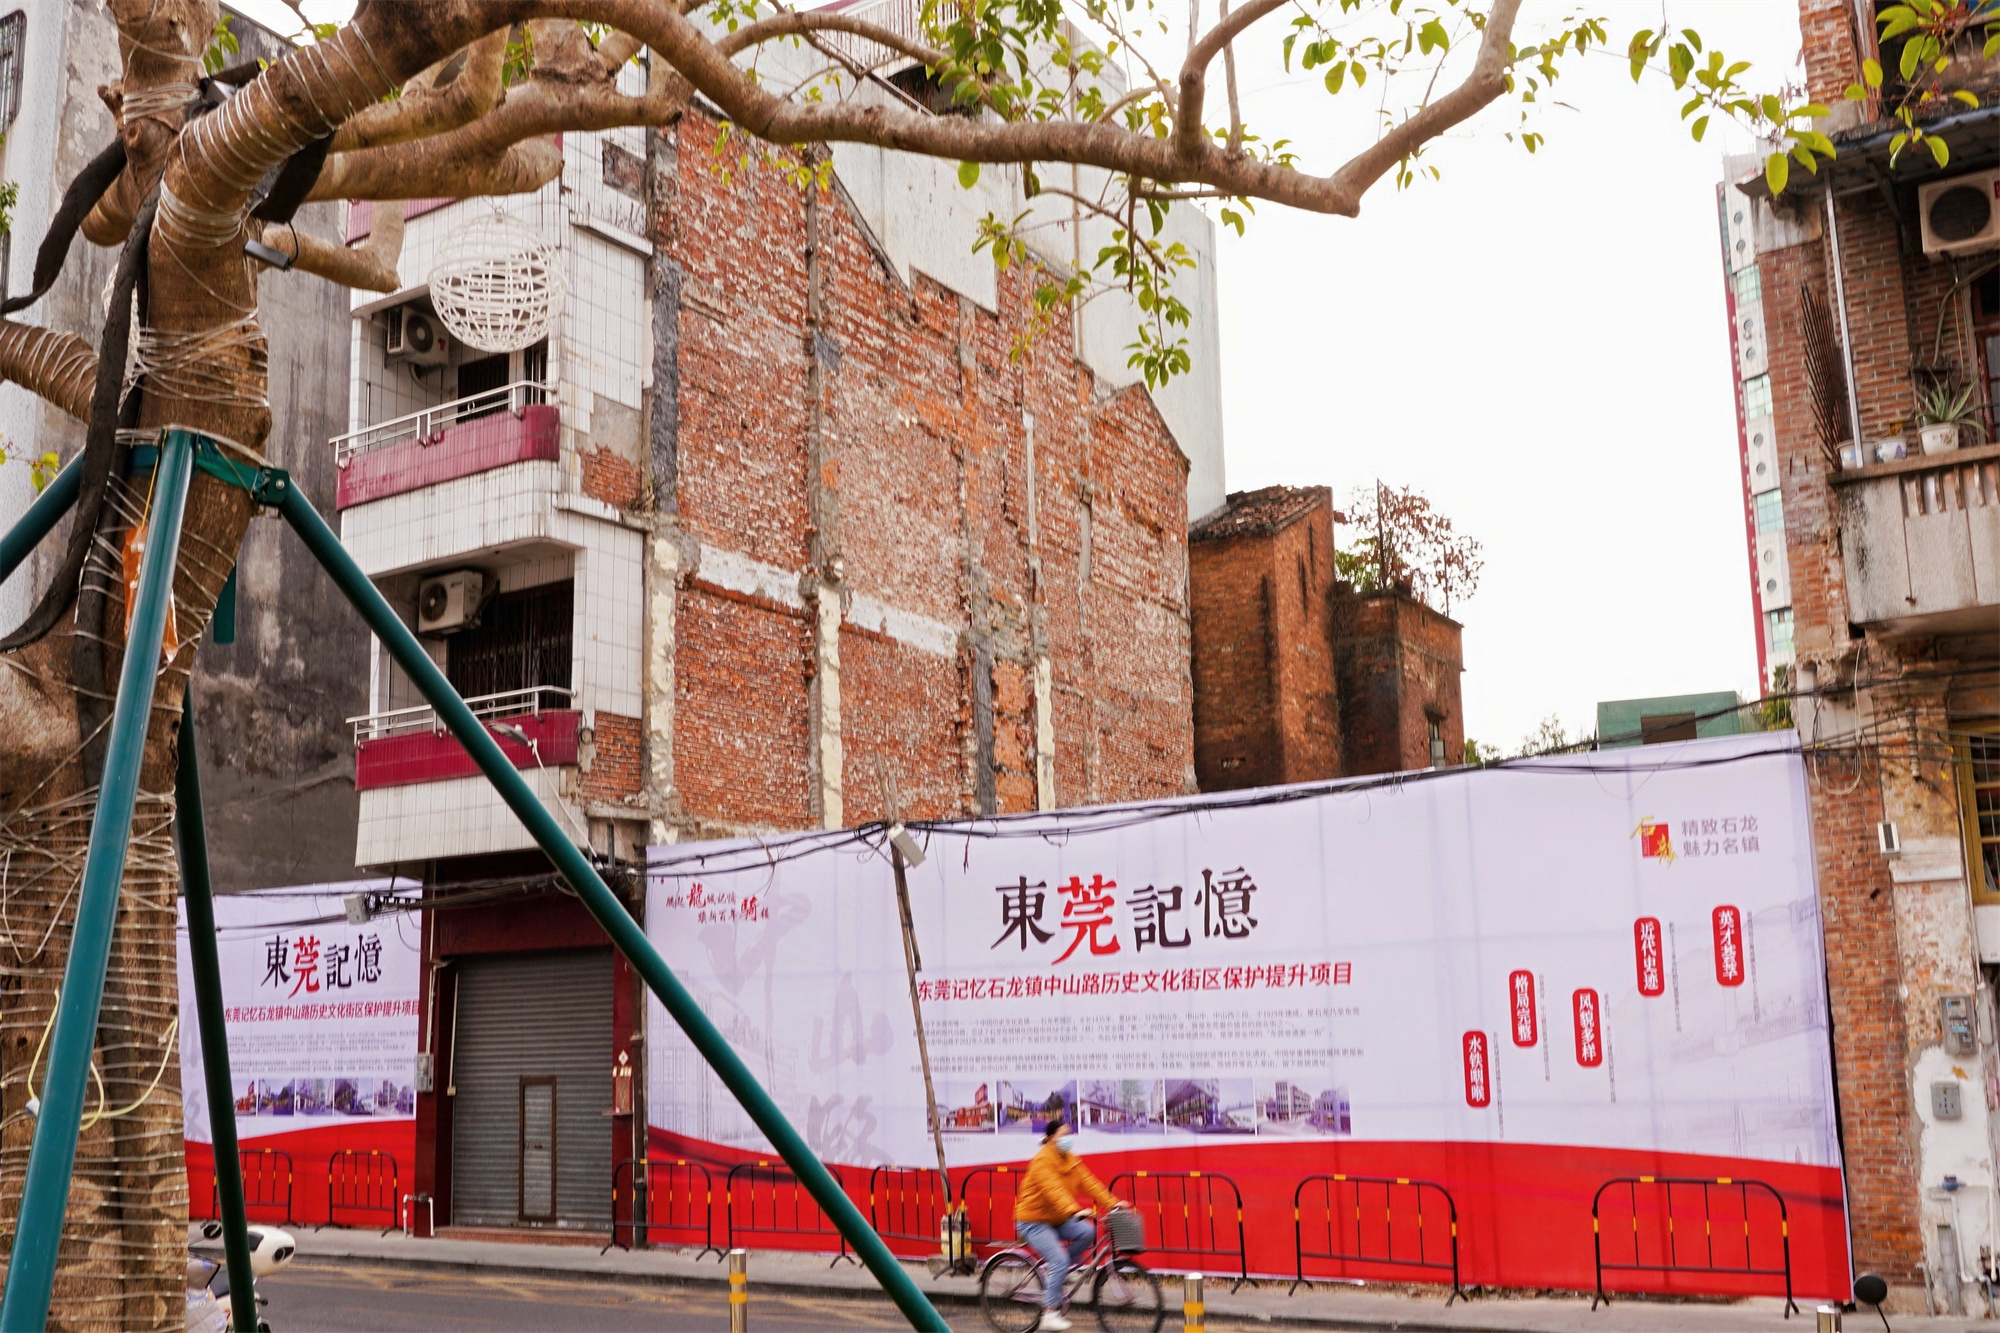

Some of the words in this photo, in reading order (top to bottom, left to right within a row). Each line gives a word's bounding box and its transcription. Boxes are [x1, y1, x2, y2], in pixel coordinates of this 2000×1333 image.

[1681, 814, 1758, 837] 精致石龙
[1683, 836, 1760, 857] 魅力名镇
[990, 866, 1258, 965] 東莞記憶
[261, 932, 383, 1000] 東莞記憶
[917, 960, 1352, 1001] 东莞记忆石龙镇中山路历史文化街区保护提升项目
[1640, 921, 1659, 991] 近代史迹
[1515, 974, 1532, 1042] 格局完整
[1579, 992, 1597, 1062] 风貌多样
[1468, 1034, 1485, 1103] 水铁咽喉
